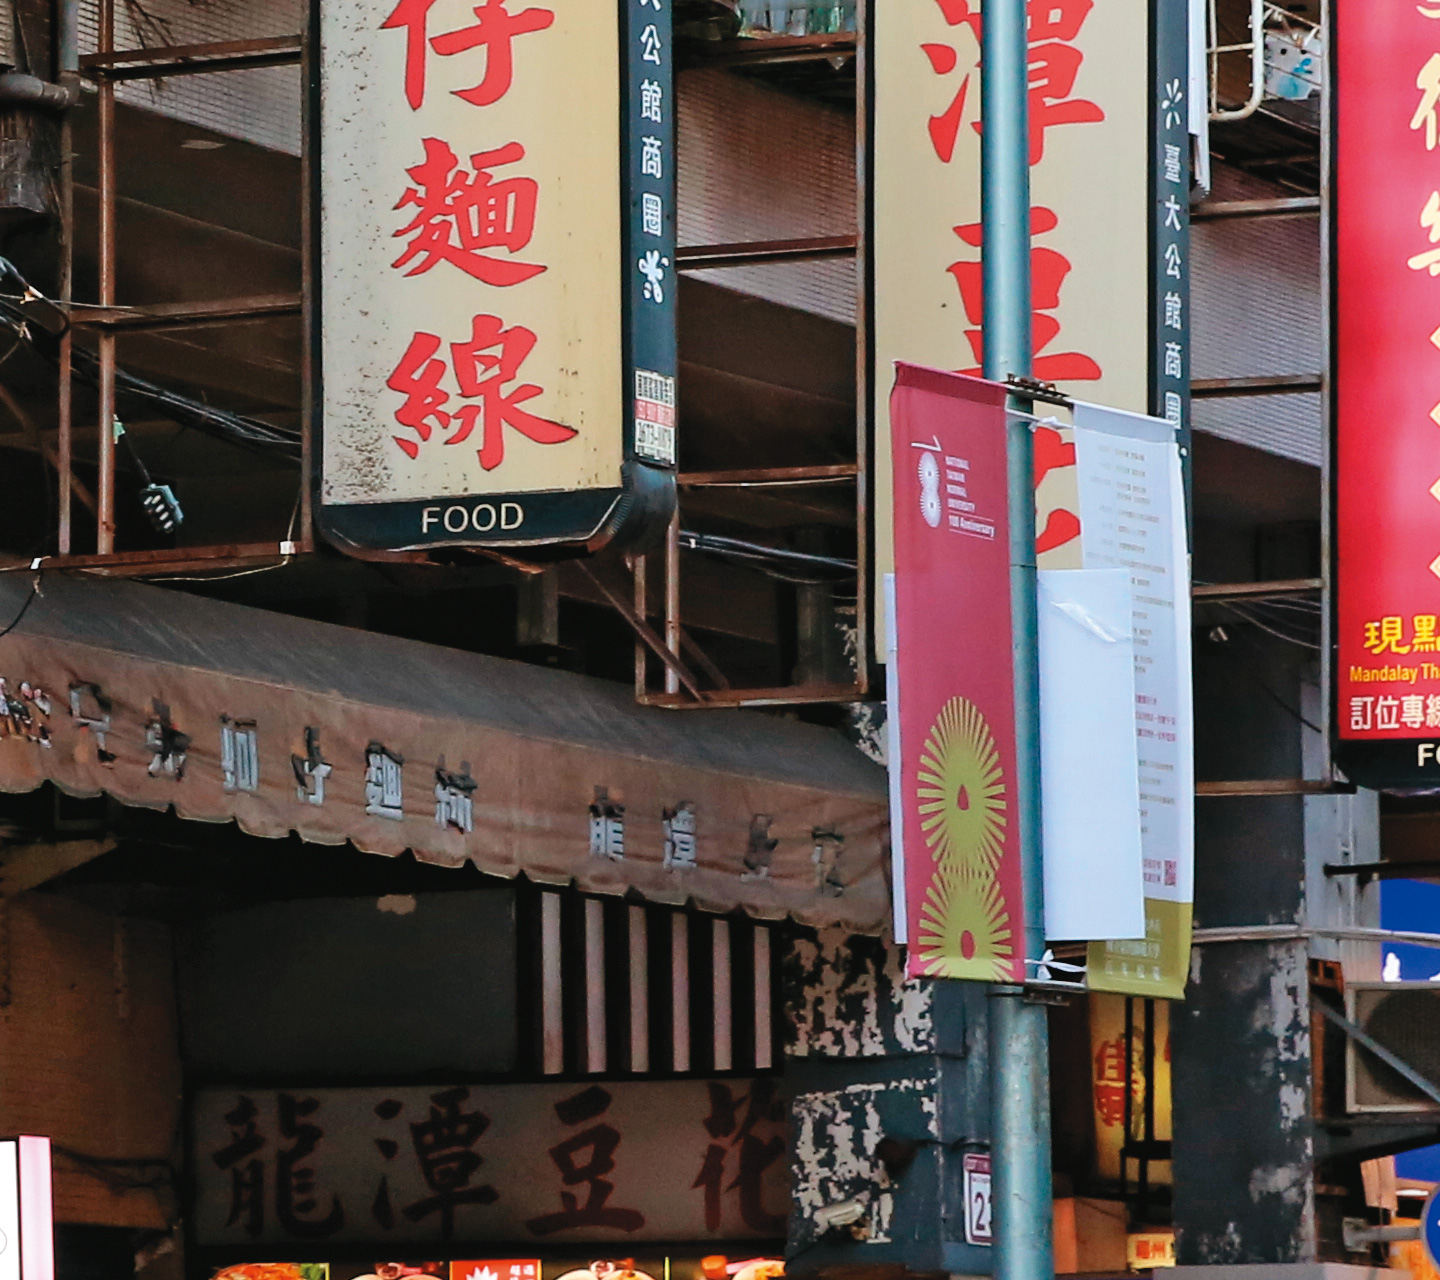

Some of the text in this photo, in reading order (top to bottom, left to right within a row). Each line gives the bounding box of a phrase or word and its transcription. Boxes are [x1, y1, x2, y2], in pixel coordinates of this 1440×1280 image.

[421, 503, 524, 534] FOOD
[1349, 664, 1418, 686] Mandalay
[212, 1085, 784, 1238] 龍潭豆花
